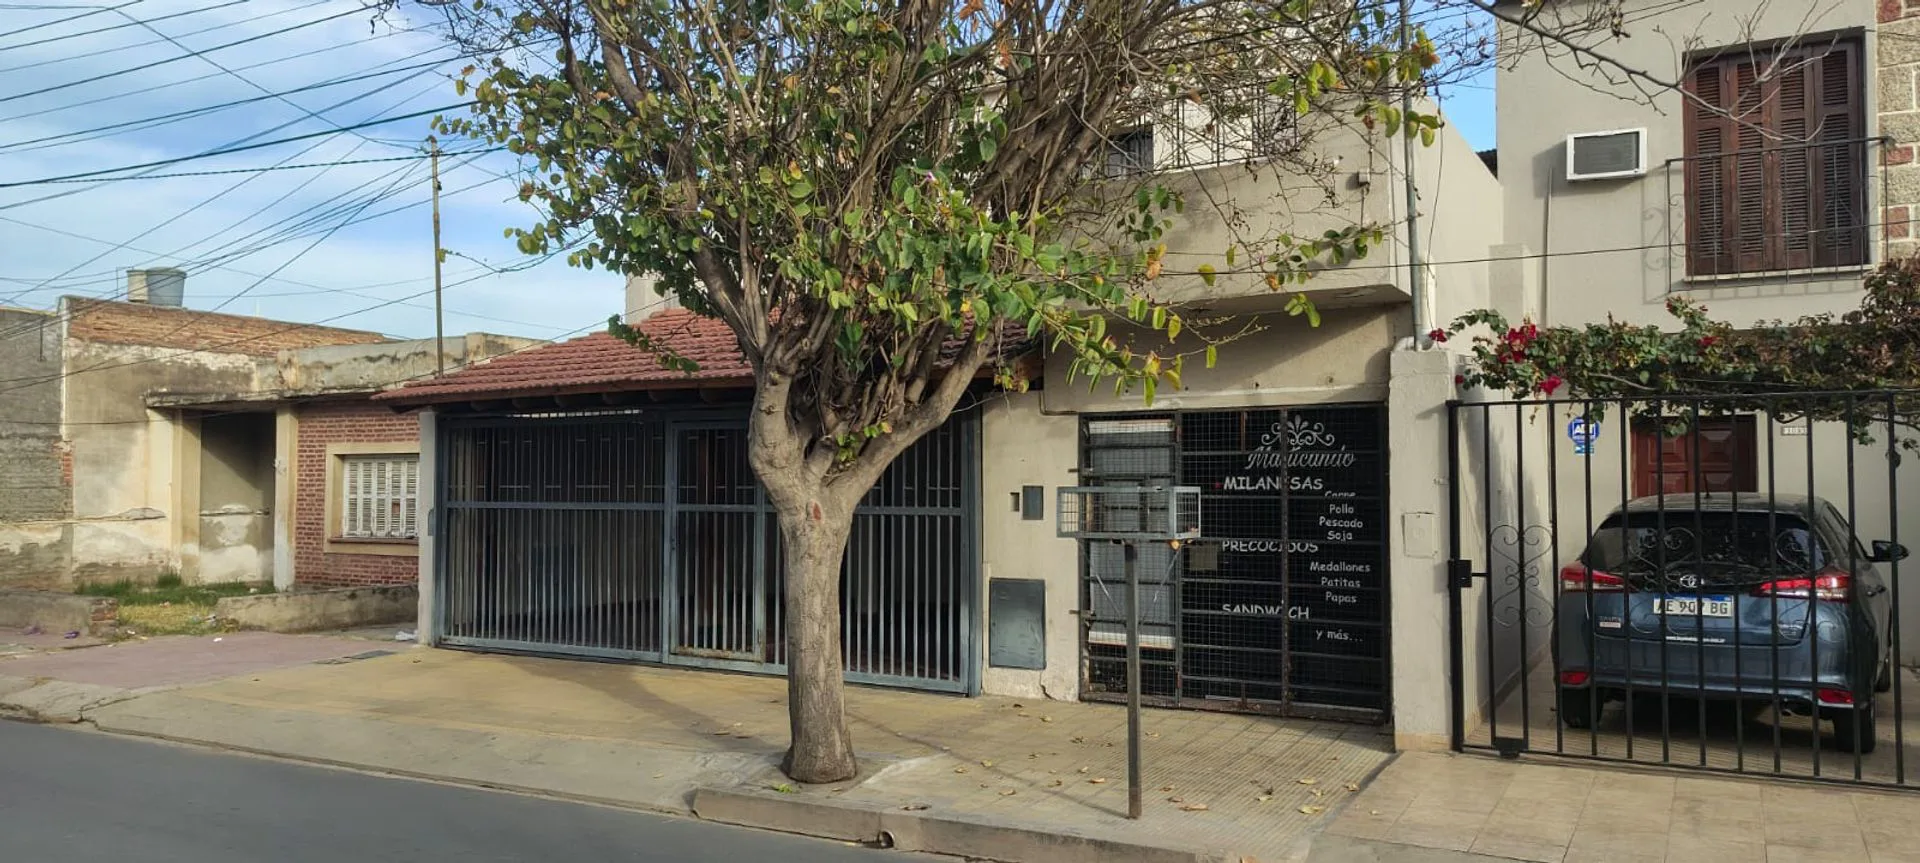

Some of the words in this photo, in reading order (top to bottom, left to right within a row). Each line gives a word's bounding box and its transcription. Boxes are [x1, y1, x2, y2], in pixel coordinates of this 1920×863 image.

[1244, 444, 1356, 470] Maticando
[1223, 475, 1324, 491] MILANSAS
[1329, 503, 1355, 514] Pollo
[1318, 516, 1364, 529] Pescado
[1326, 530, 1353, 542] Soja
[1309, 561, 1371, 573] Medallones
[1321, 577, 1361, 588] Patitas
[1325, 591, 1357, 606] Papas
[1221, 603, 1310, 620] SANDWCH
[1710, 602, 1728, 615] BG
[1316, 629, 1323, 641] y
